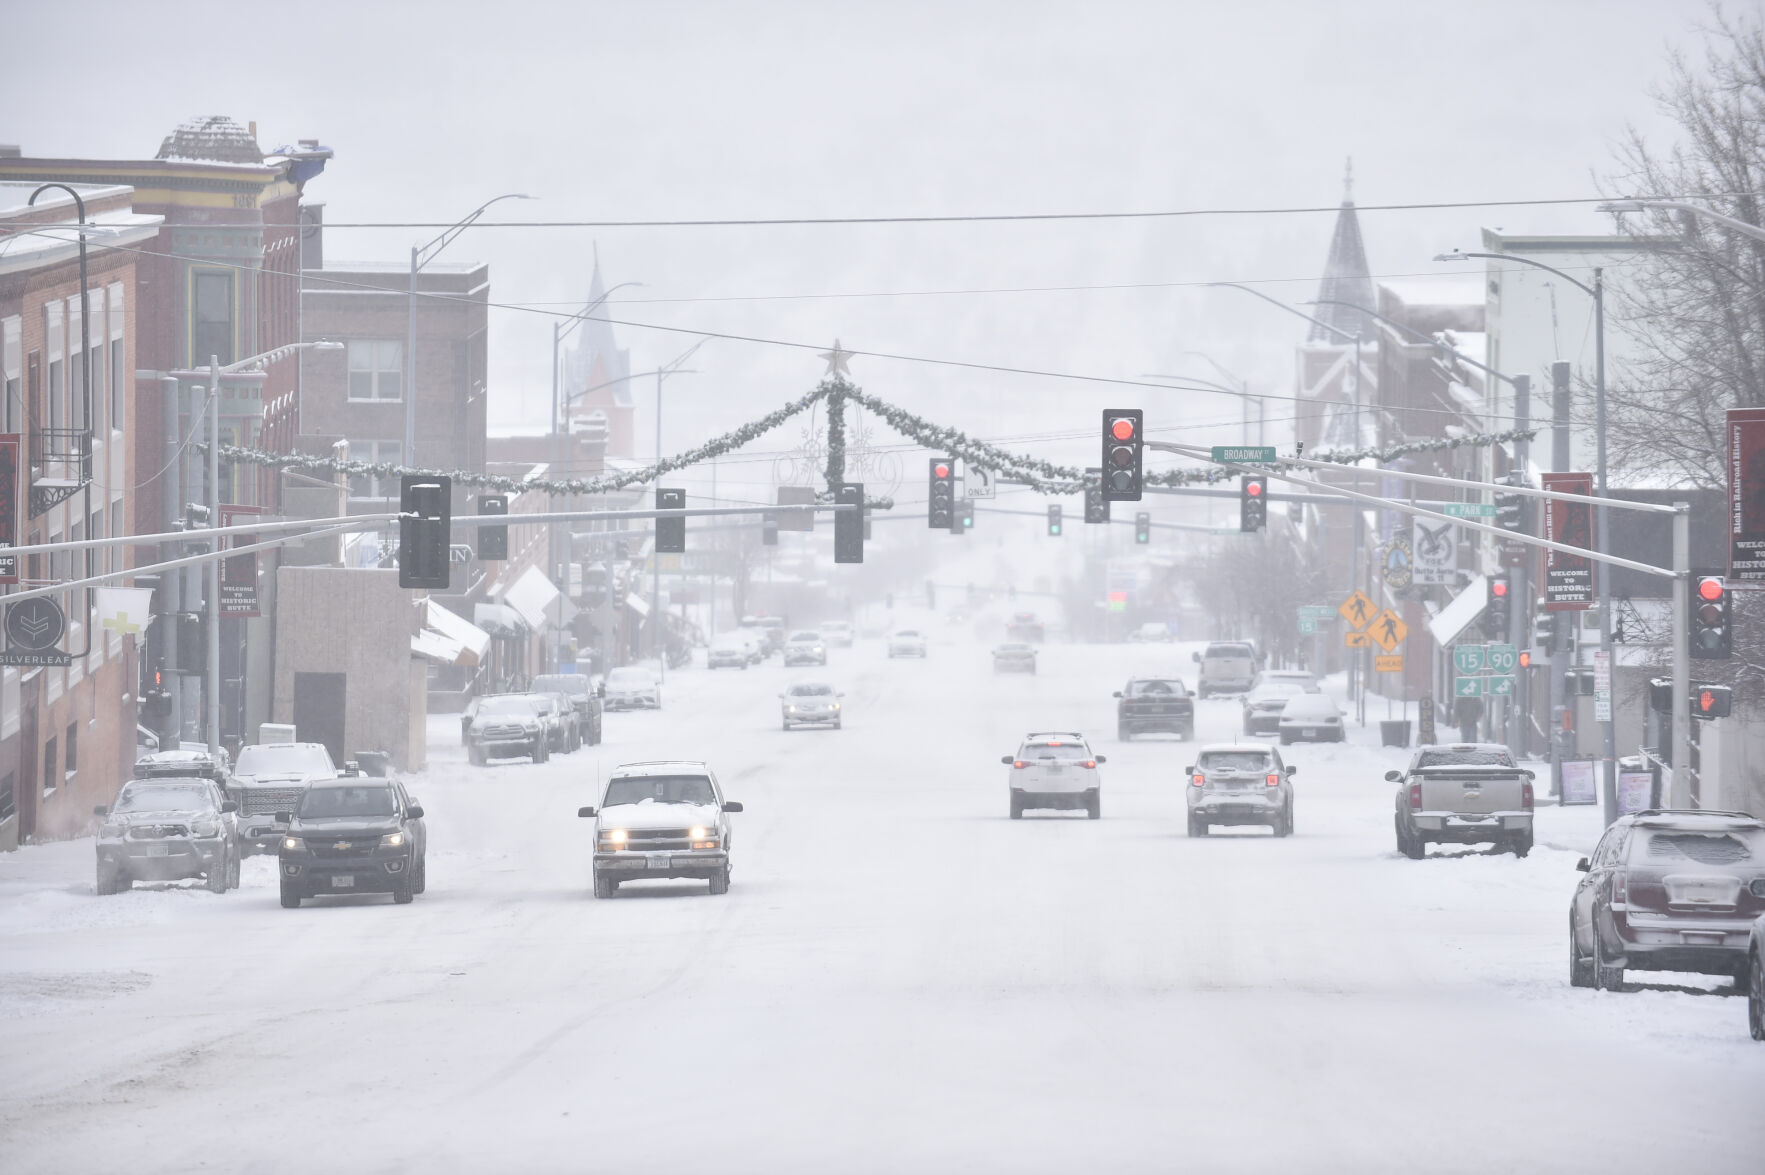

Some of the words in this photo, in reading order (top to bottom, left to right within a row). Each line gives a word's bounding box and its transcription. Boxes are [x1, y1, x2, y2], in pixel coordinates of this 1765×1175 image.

[1733, 425, 1742, 460] History
[1224, 449, 1262, 460] BROADWAY
[1733, 461, 1741, 501] Railroad
[968, 488, 990, 496] ONLY
[1460, 504, 1481, 516] PARK
[1733, 502, 1741, 512] in
[1733, 513, 1741, 533] Rich
[1732, 560, 1765, 568] HISTO
[0, 655, 70, 664] SILVERLEAF
[1376, 660, 1402, 668] AHEAD
[1461, 654, 1478, 668] 15
[1492, 653, 1513, 668] 90
